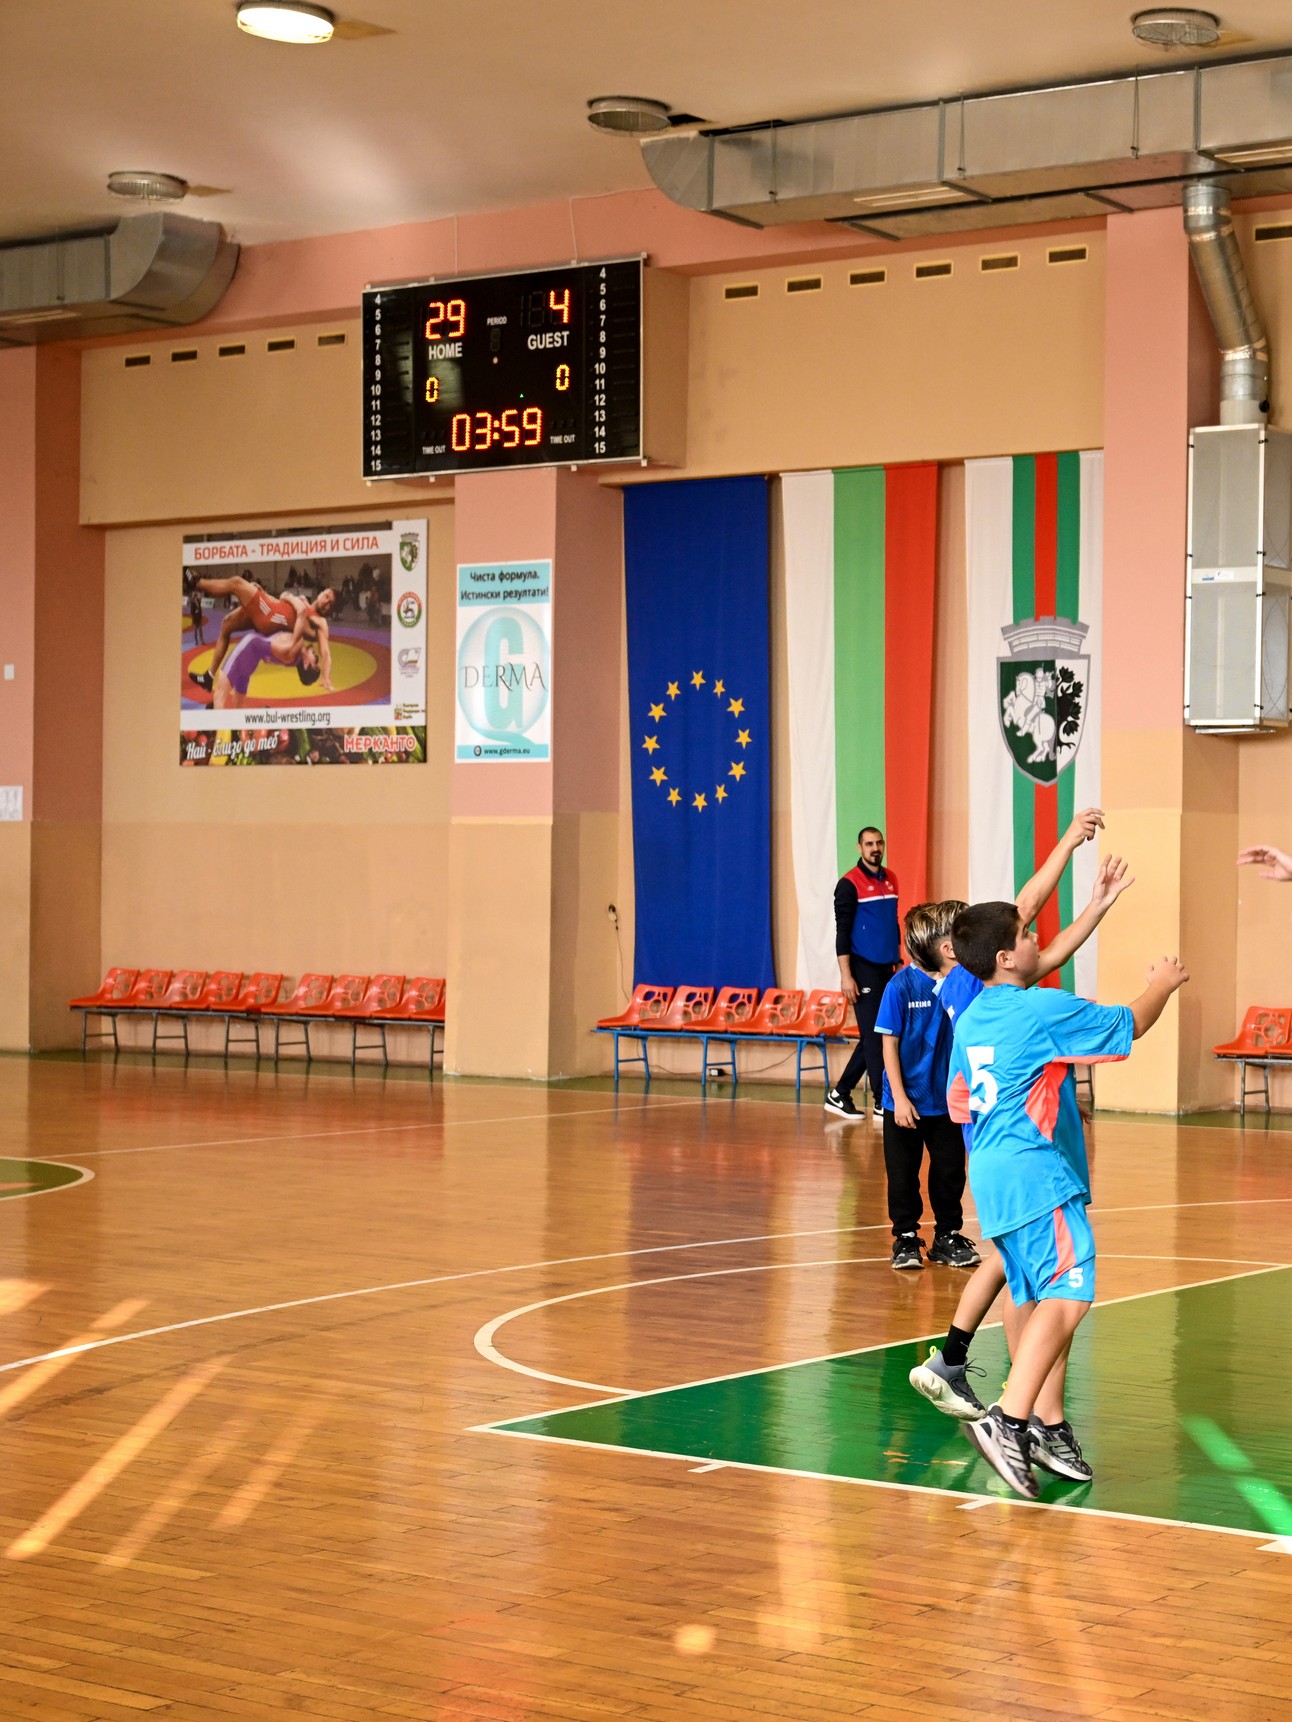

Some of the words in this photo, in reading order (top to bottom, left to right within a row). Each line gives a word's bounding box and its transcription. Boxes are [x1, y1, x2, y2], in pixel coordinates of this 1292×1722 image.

[600, 267, 606, 278] 4
[600, 283, 606, 295] 5
[375, 294, 381, 304] 4
[600, 299, 606, 311] 6
[549, 288, 570, 324] 4
[375, 309, 381, 320] 5
[425, 299, 466, 340] 29
[487, 315, 507, 325] PERIOD
[600, 315, 606, 327] 7
[375, 324, 381, 335] 6
[527, 331, 570, 350] GUEST
[600, 331, 606, 343] 8
[375, 339, 381, 350] 7
[428, 342, 463, 360] HOME
[600, 347, 606, 359] 9
[375, 354, 381, 365] 8
[375, 370, 381, 380] 9
[594, 363, 606, 375] 10
[555, 363, 570, 391] 0
[371, 385, 381, 396] 10
[425, 377, 439, 403] 0
[594, 379, 606, 390] 11
[371, 400, 381, 410] 11
[594, 394, 606, 406] 12
[371, 415, 381, 426] 12
[594, 410, 606, 422] 13
[452, 407, 543, 451] 03:59
[594, 426, 606, 438] 14
[371, 430, 381, 441] 13
[550, 435, 562, 444] TIME
[563, 434, 575, 443] OUT
[371, 445, 381, 456] 14
[422, 446, 433, 455] TIME
[434, 445, 446, 454] OUT
[594, 442, 606, 454] 15
[371, 460, 381, 471] 15
[194, 544, 248, 561] БОРБАТА
[259, 539, 327, 557] ТРАДИЦИЯ
[331, 538, 340, 552] И
[343, 536, 379, 551] СИЛА
[470, 572, 496, 582] Чиста
[498, 570, 540, 583] формула.
[461, 590, 500, 600] Истински
[503, 587, 549, 601] резултати!
[460, 662, 548, 692] DERMA
[244, 710, 331, 726] www.bul-wrestling.org
[243, 738, 256, 757] до
[257, 731, 280, 751] теб
[343, 735, 417, 752] МЕРКАНТО
[484, 746, 530, 756] www.gderma.eu
[966, 1046, 999, 1115] 5
[1068, 1267, 1083, 1288] 5
